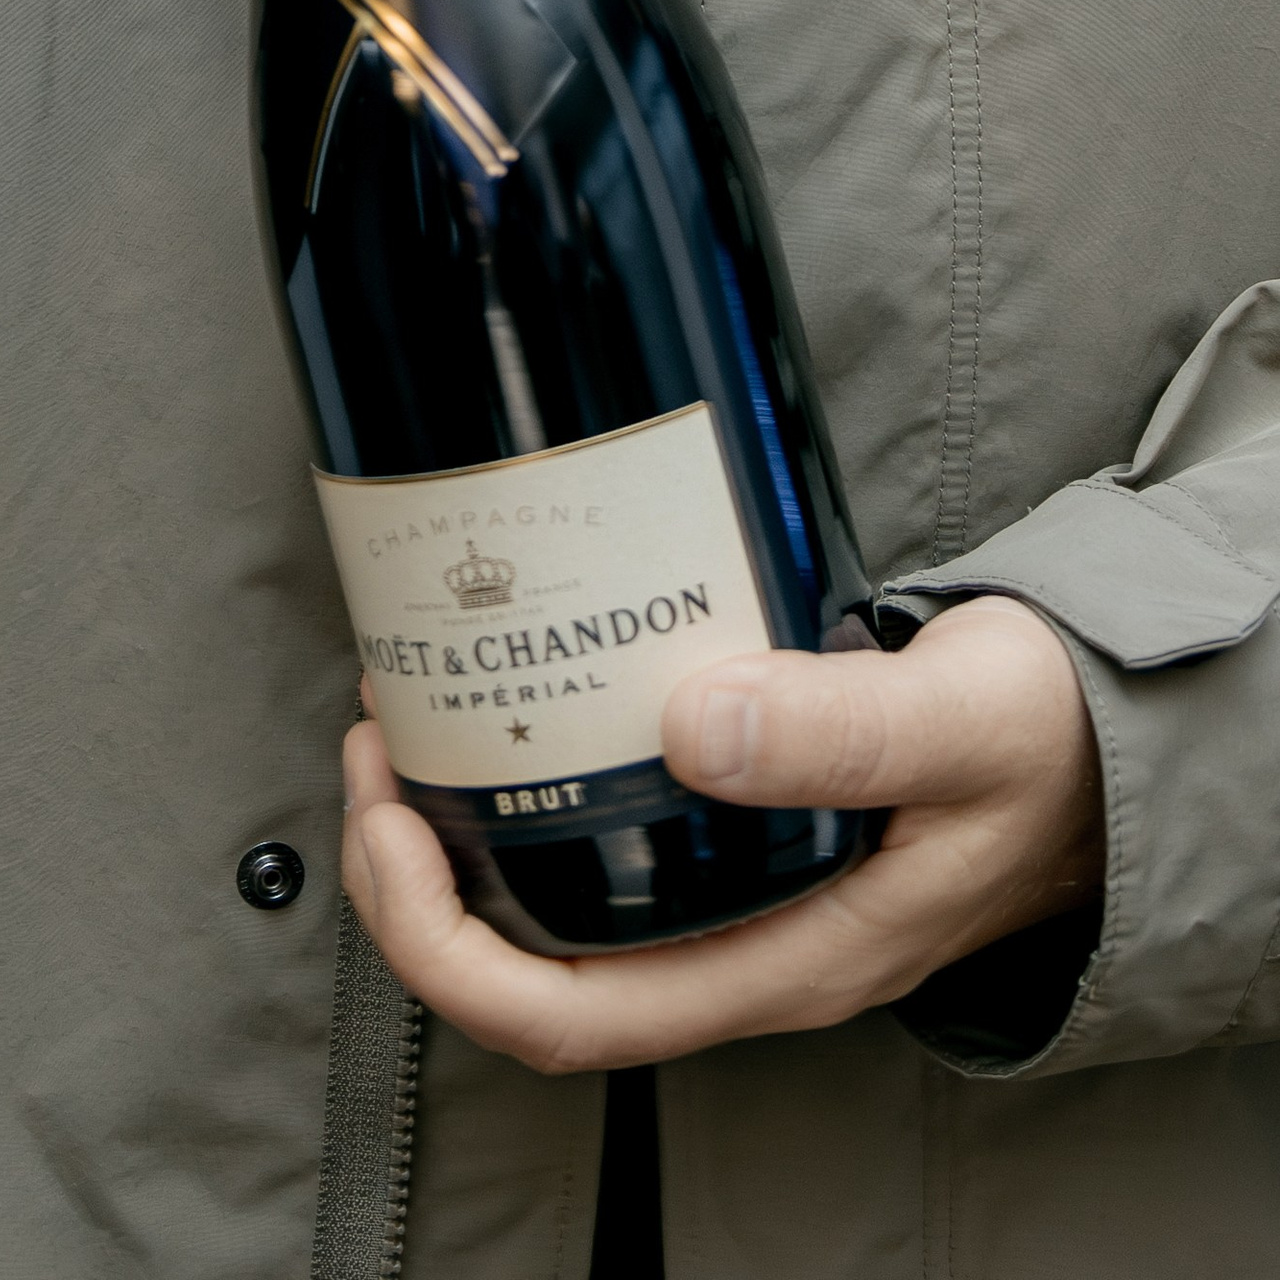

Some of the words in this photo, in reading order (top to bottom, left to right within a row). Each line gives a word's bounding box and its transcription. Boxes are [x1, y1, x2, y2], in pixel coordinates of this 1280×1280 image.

[368, 505, 605, 558] CHAMPAGNE
[443, 645, 469, 675] &
[474, 582, 713, 672] CHANDON
[431, 671, 607, 710] IMPÉRIAL
[494, 781, 588, 816] BRUT
